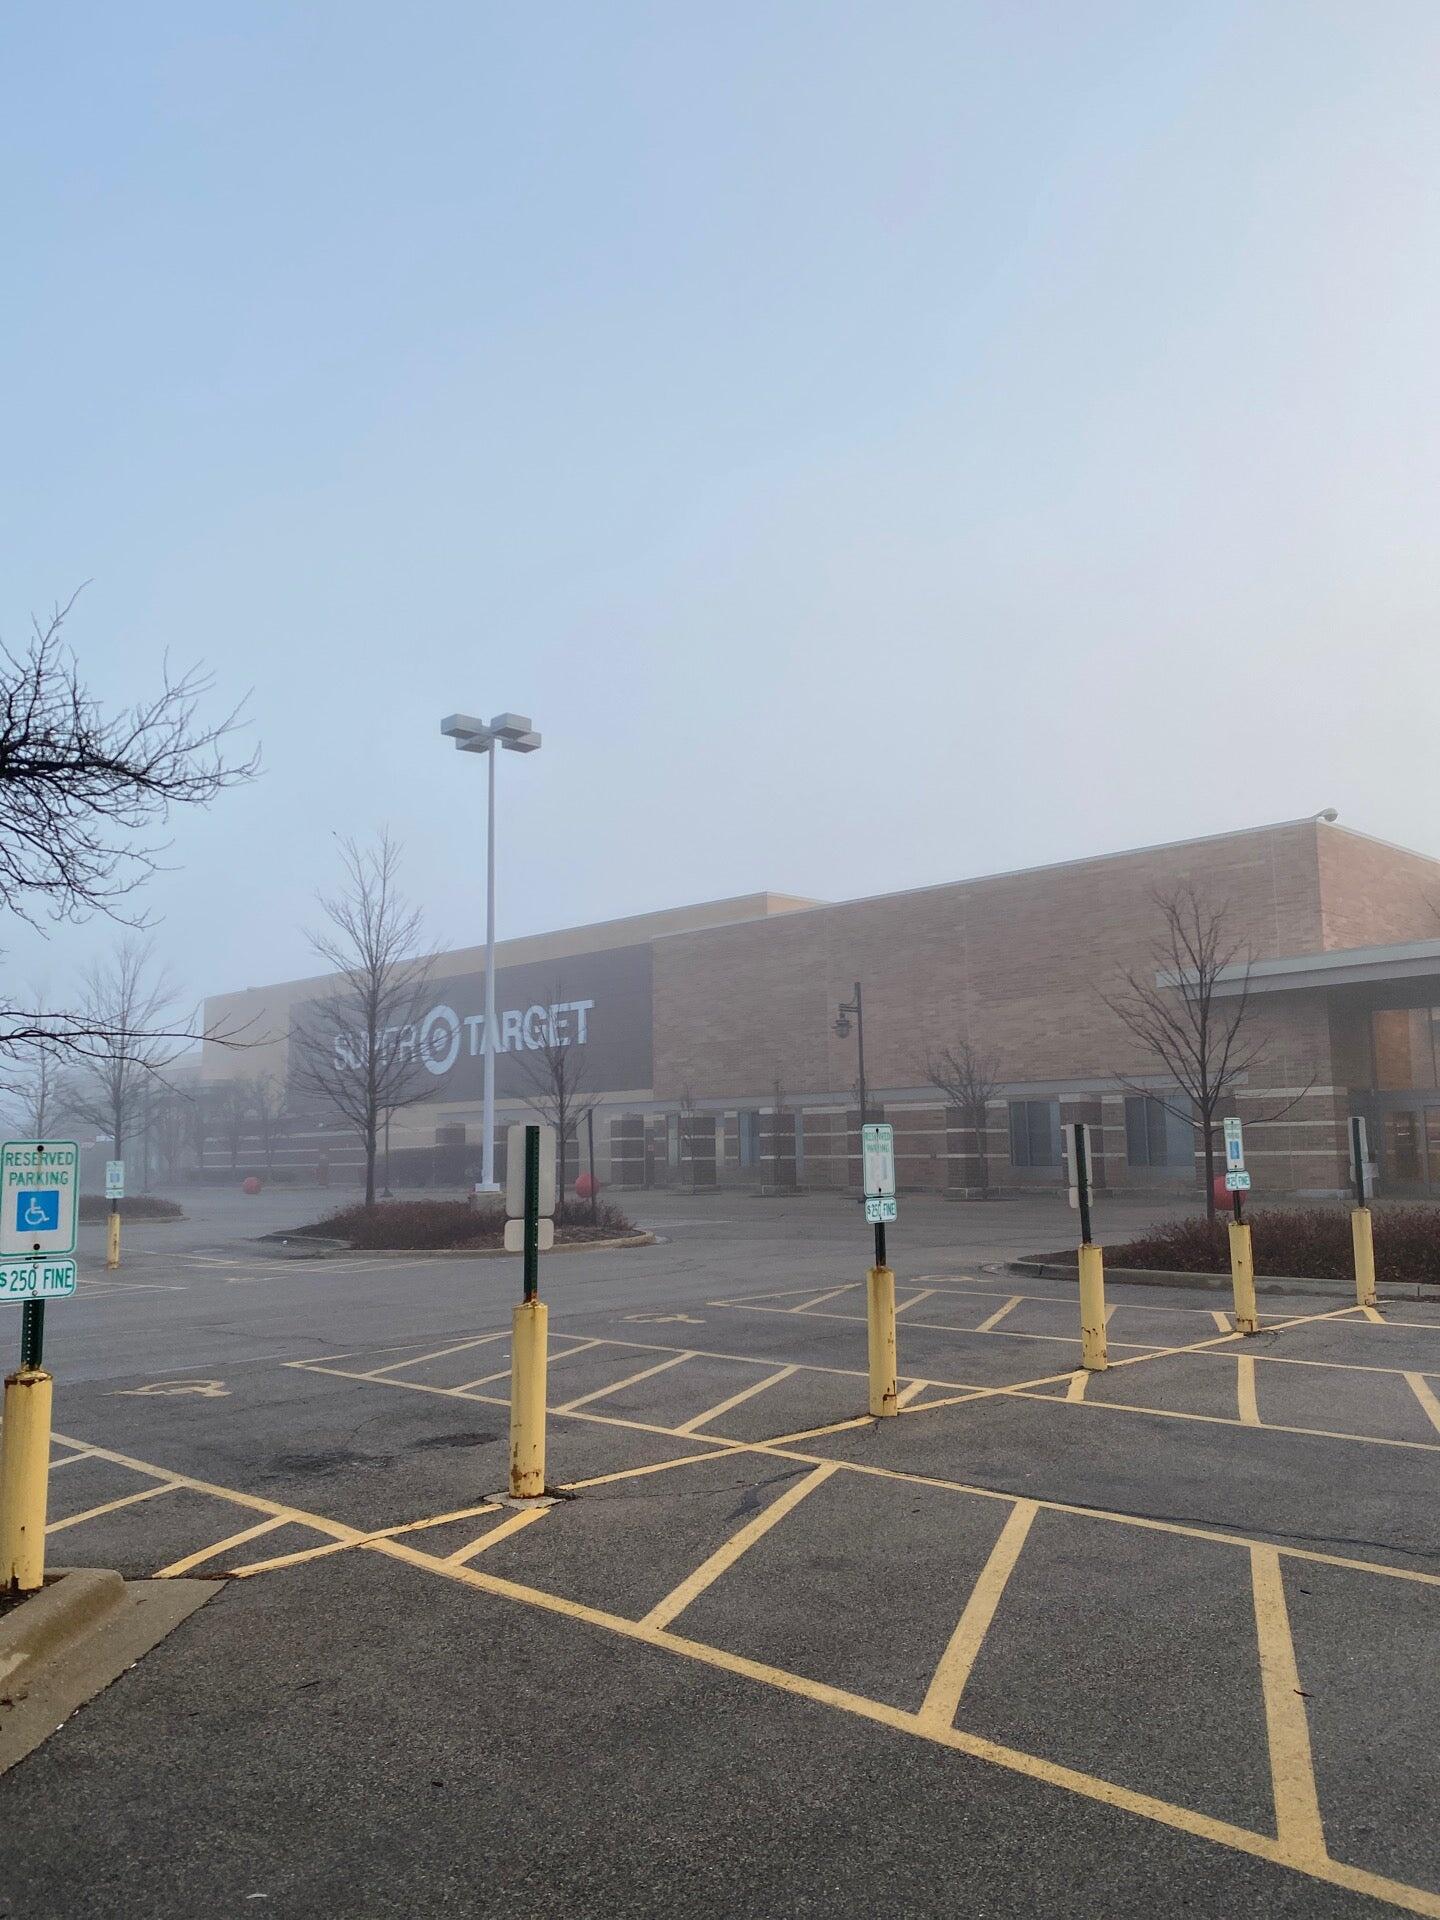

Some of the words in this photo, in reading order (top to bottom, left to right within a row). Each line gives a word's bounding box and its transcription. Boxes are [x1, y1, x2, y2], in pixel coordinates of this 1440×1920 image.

[463, 1000, 596, 1056] TARGET
[5, 1151, 74, 1167] RESERVED
[9, 1171, 69, 1186] PARKING
[43, 1267, 73, 1290] FINE
